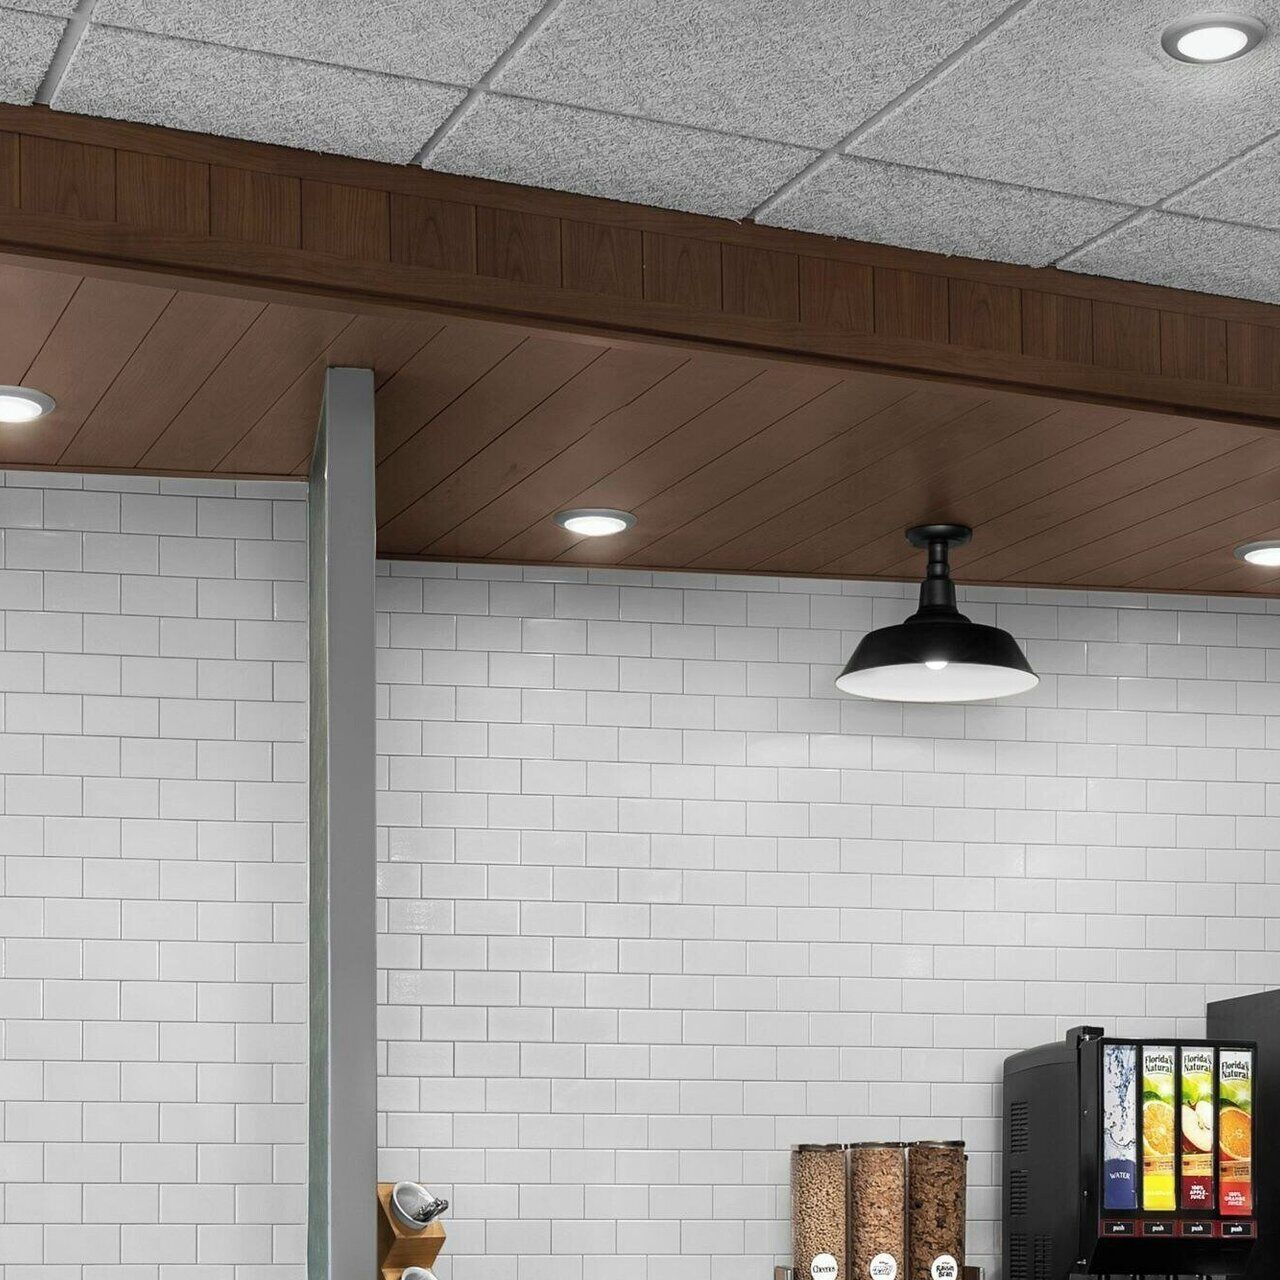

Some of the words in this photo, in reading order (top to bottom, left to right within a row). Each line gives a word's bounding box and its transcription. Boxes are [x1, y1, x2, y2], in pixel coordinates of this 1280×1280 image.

[1145, 1063, 1172, 1074] Natural
[1184, 1063, 1211, 1074] Natural
[1221, 1069, 1249, 1080] Natural
[1109, 1171, 1131, 1180] WATER
